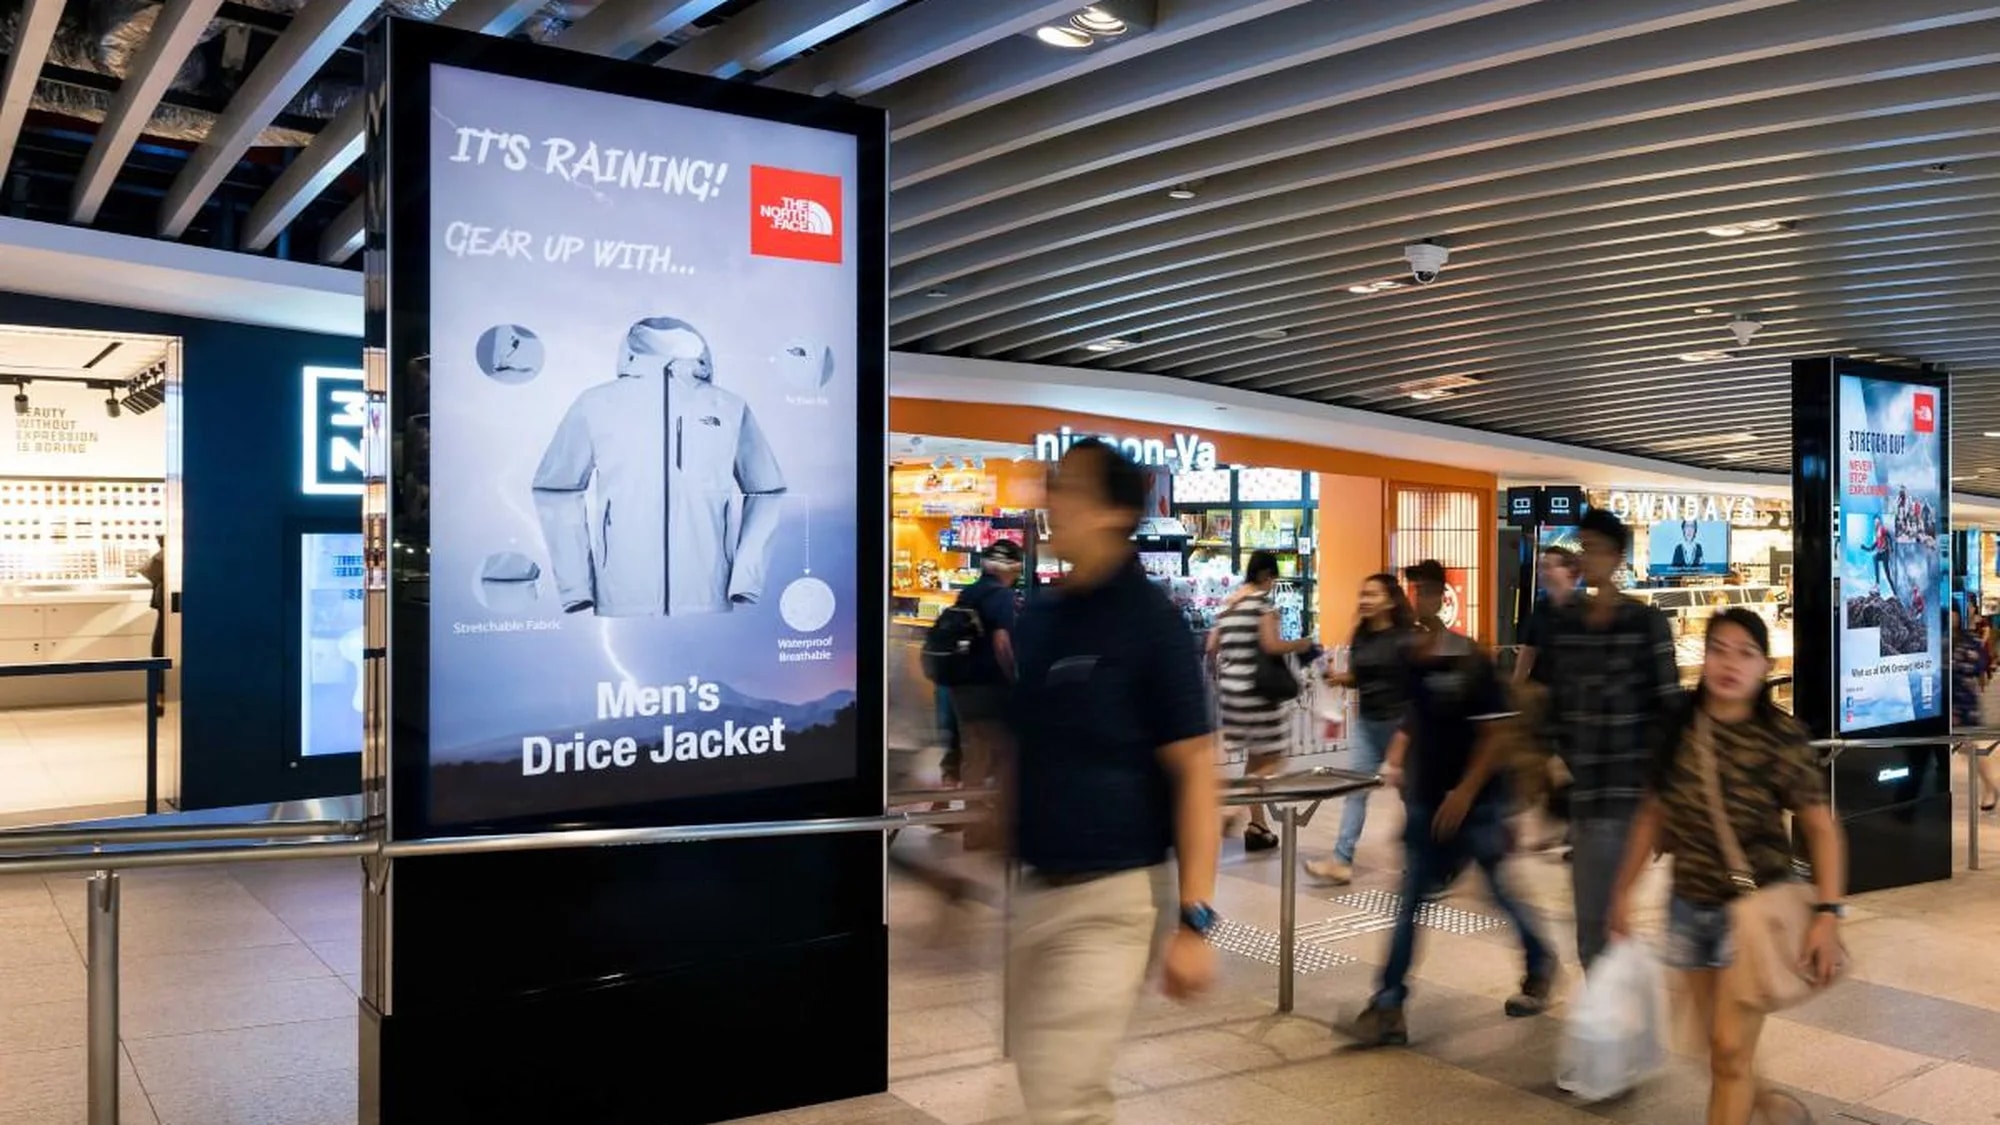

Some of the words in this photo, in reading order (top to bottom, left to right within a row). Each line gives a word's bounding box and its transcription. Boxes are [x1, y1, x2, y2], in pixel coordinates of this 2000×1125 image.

[449, 127, 530, 171] IT'S
[541, 138, 729, 203] RAINING!
[781, 196, 808, 209] THE
[760, 204, 808, 221] NORTH
[445, 221, 532, 261] GEAR
[544, 235, 584, 264] UP
[594, 239, 696, 276] WITH...
[15, 418, 77, 430] WITHOUT
[1849, 430, 1888, 454] STRETCH
[1890, 434, 1905, 455] OUT
[1849, 460, 1872, 472] NEVER
[1849, 472, 1867, 483] STOP
[1608, 491, 1755, 524] OWNDAYS
[453, 619, 524, 634] Stretchable
[526, 617, 562, 631] Fabric
[778, 635, 834, 649] Waterproof
[779, 649, 832, 662] Breathable
[596, 675, 720, 720] Men's
[522, 731, 637, 777] Drice
[650, 716, 786, 764] Jacket
